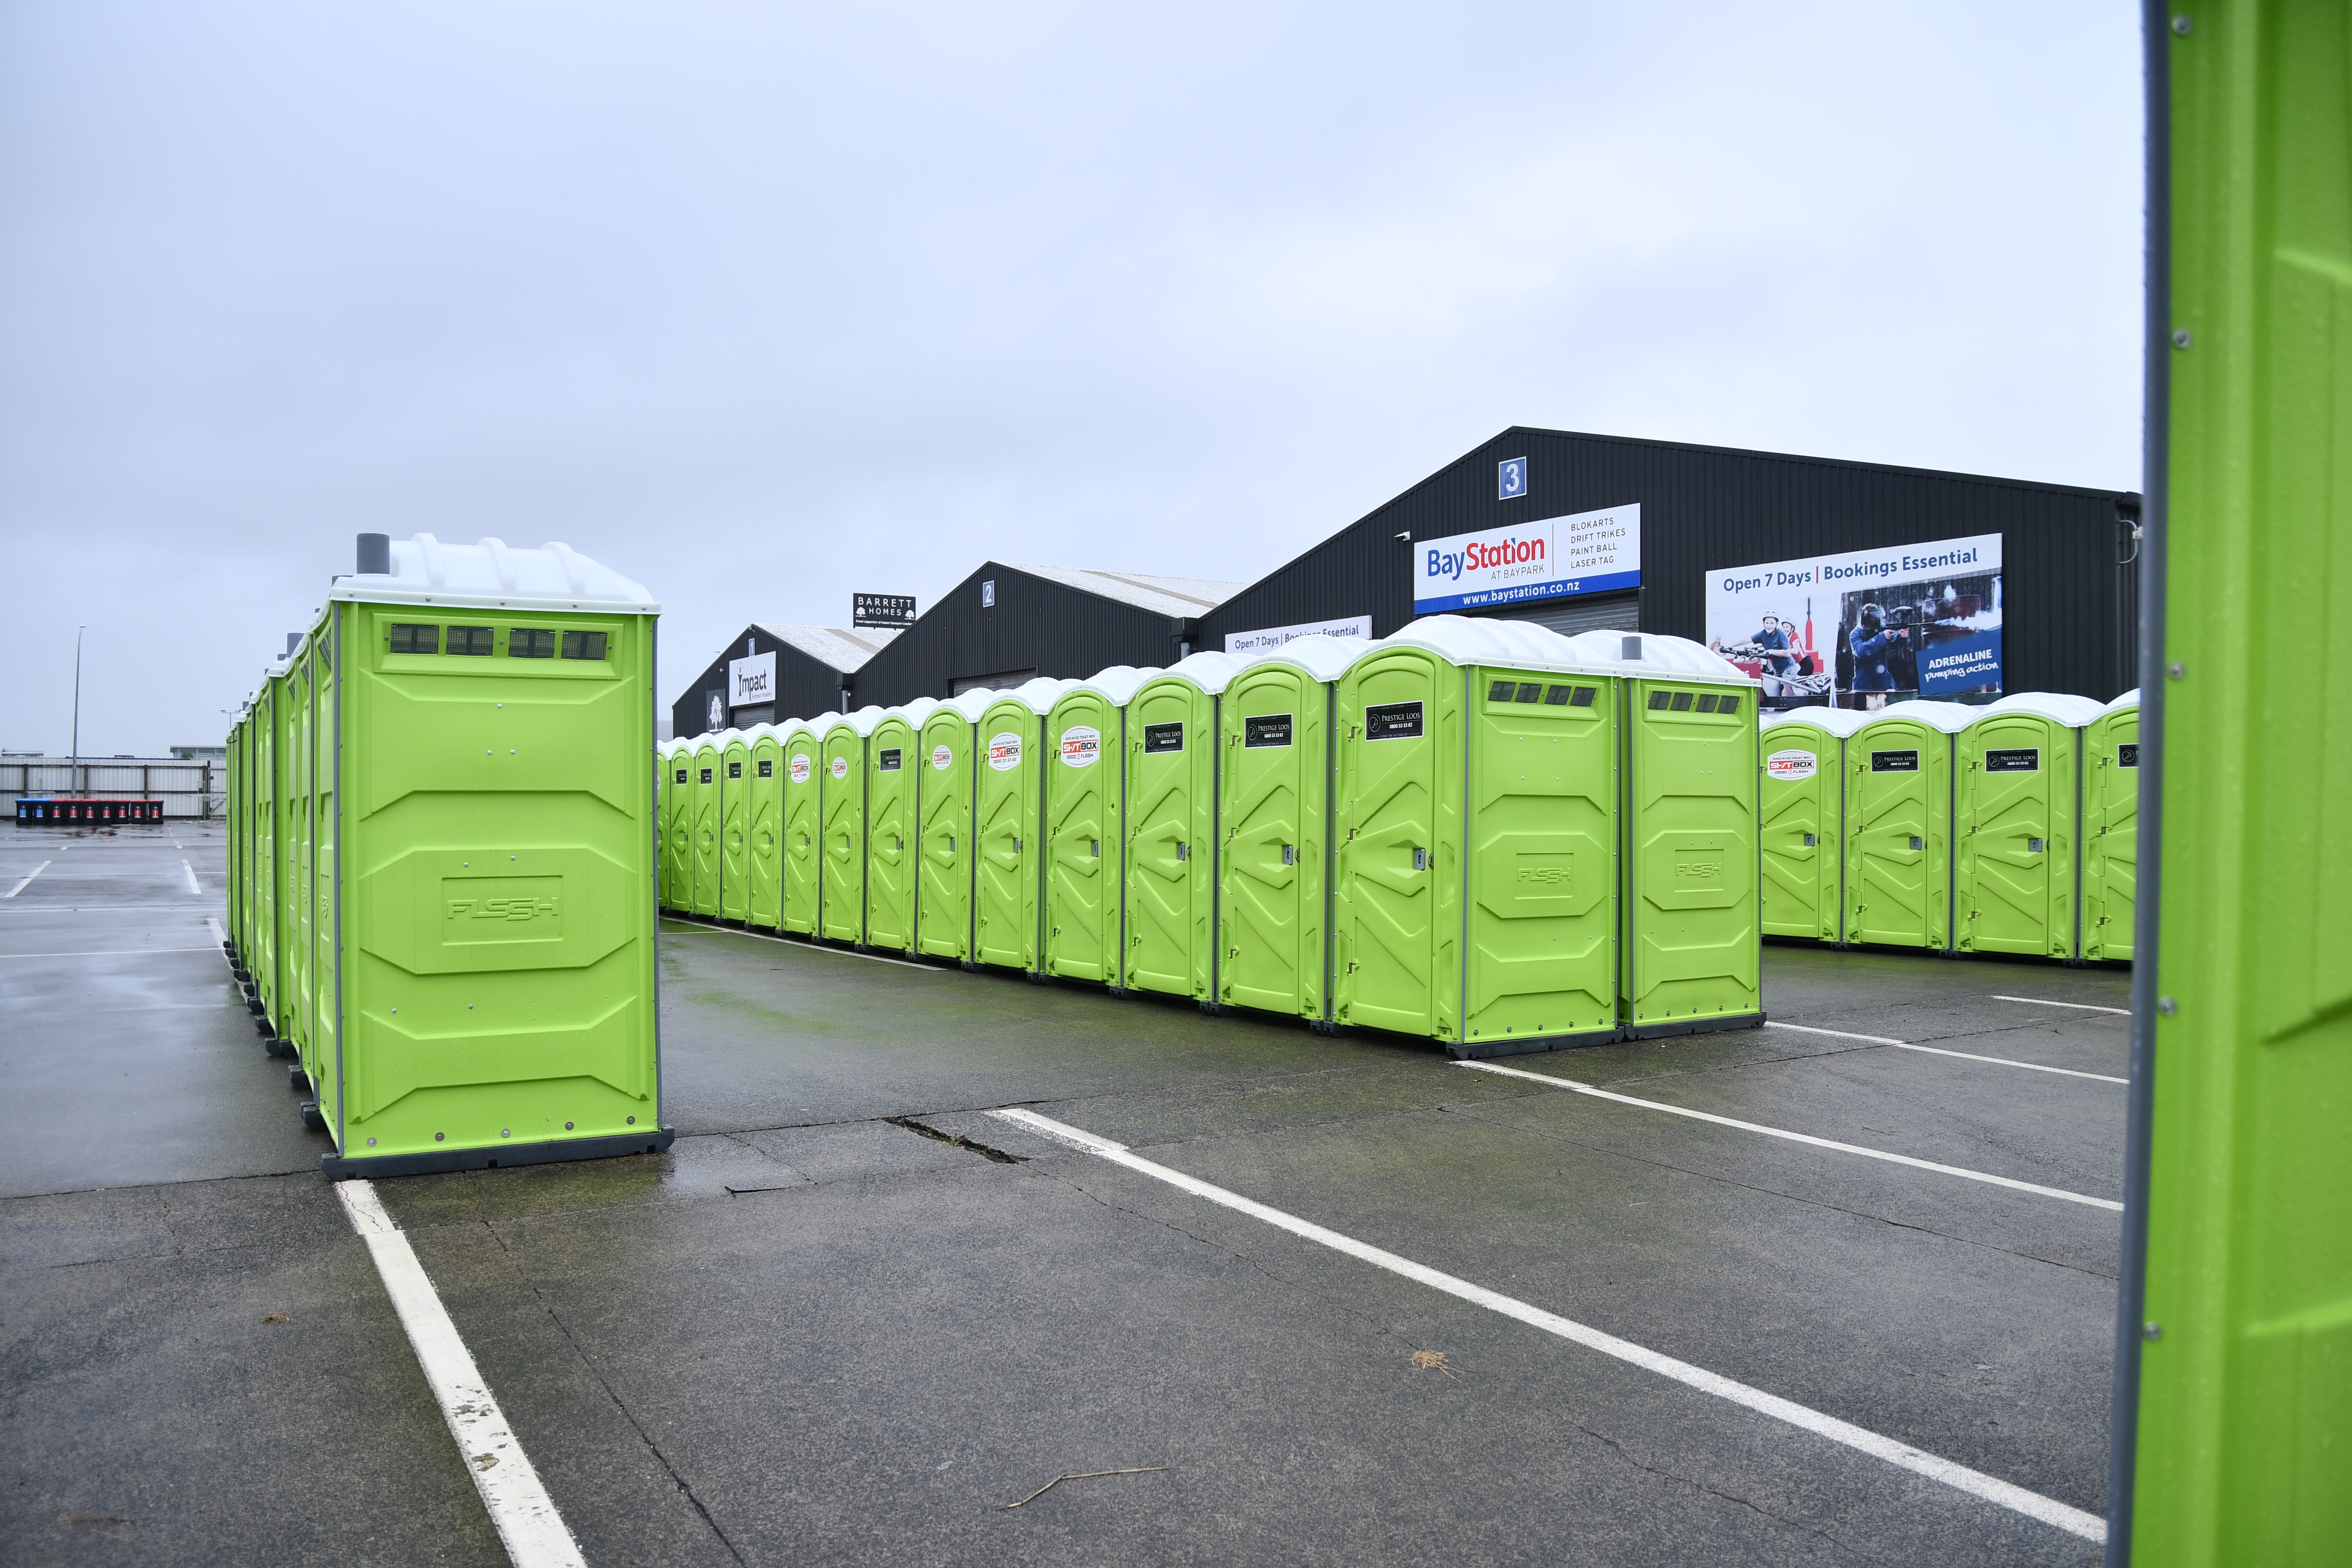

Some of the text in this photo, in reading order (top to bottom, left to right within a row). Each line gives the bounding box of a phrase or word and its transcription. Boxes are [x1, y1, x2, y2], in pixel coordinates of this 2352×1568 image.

[1505, 463, 1519, 492] 3
[1571, 517, 1614, 531] BLOKARTS
[1571, 528, 1625, 544] DRIFT TRIKES
[1571, 542, 1617, 556] PAINT BALL
[1428, 537, 1545, 581] BayStation
[1571, 555, 1614, 569] LASER TAG
[1491, 564, 1544, 580] AT BAYPARK
[1723, 547, 1977, 593] Open 7 Days Bookings Essential
[985, 585, 992, 603] 2
[1463, 582, 1579, 604] www.baystation.co.nz
[858, 597, 912, 608] BARRETT
[869, 607, 901, 616] HOMES
[750, 640, 753, 654] 1
[1235, 640, 1254, 651] Open
[1255, 637, 1260, 647] 7
[1262, 637, 1279, 647] Days
[1928, 649, 1993, 669] ADRENALINE
[1925, 662, 1998, 682] pumping action
[1382, 714, 1405, 722] PRESTIGE
[1006, 746, 1018, 754] BOX
[1081, 742, 1097, 750] BOX
